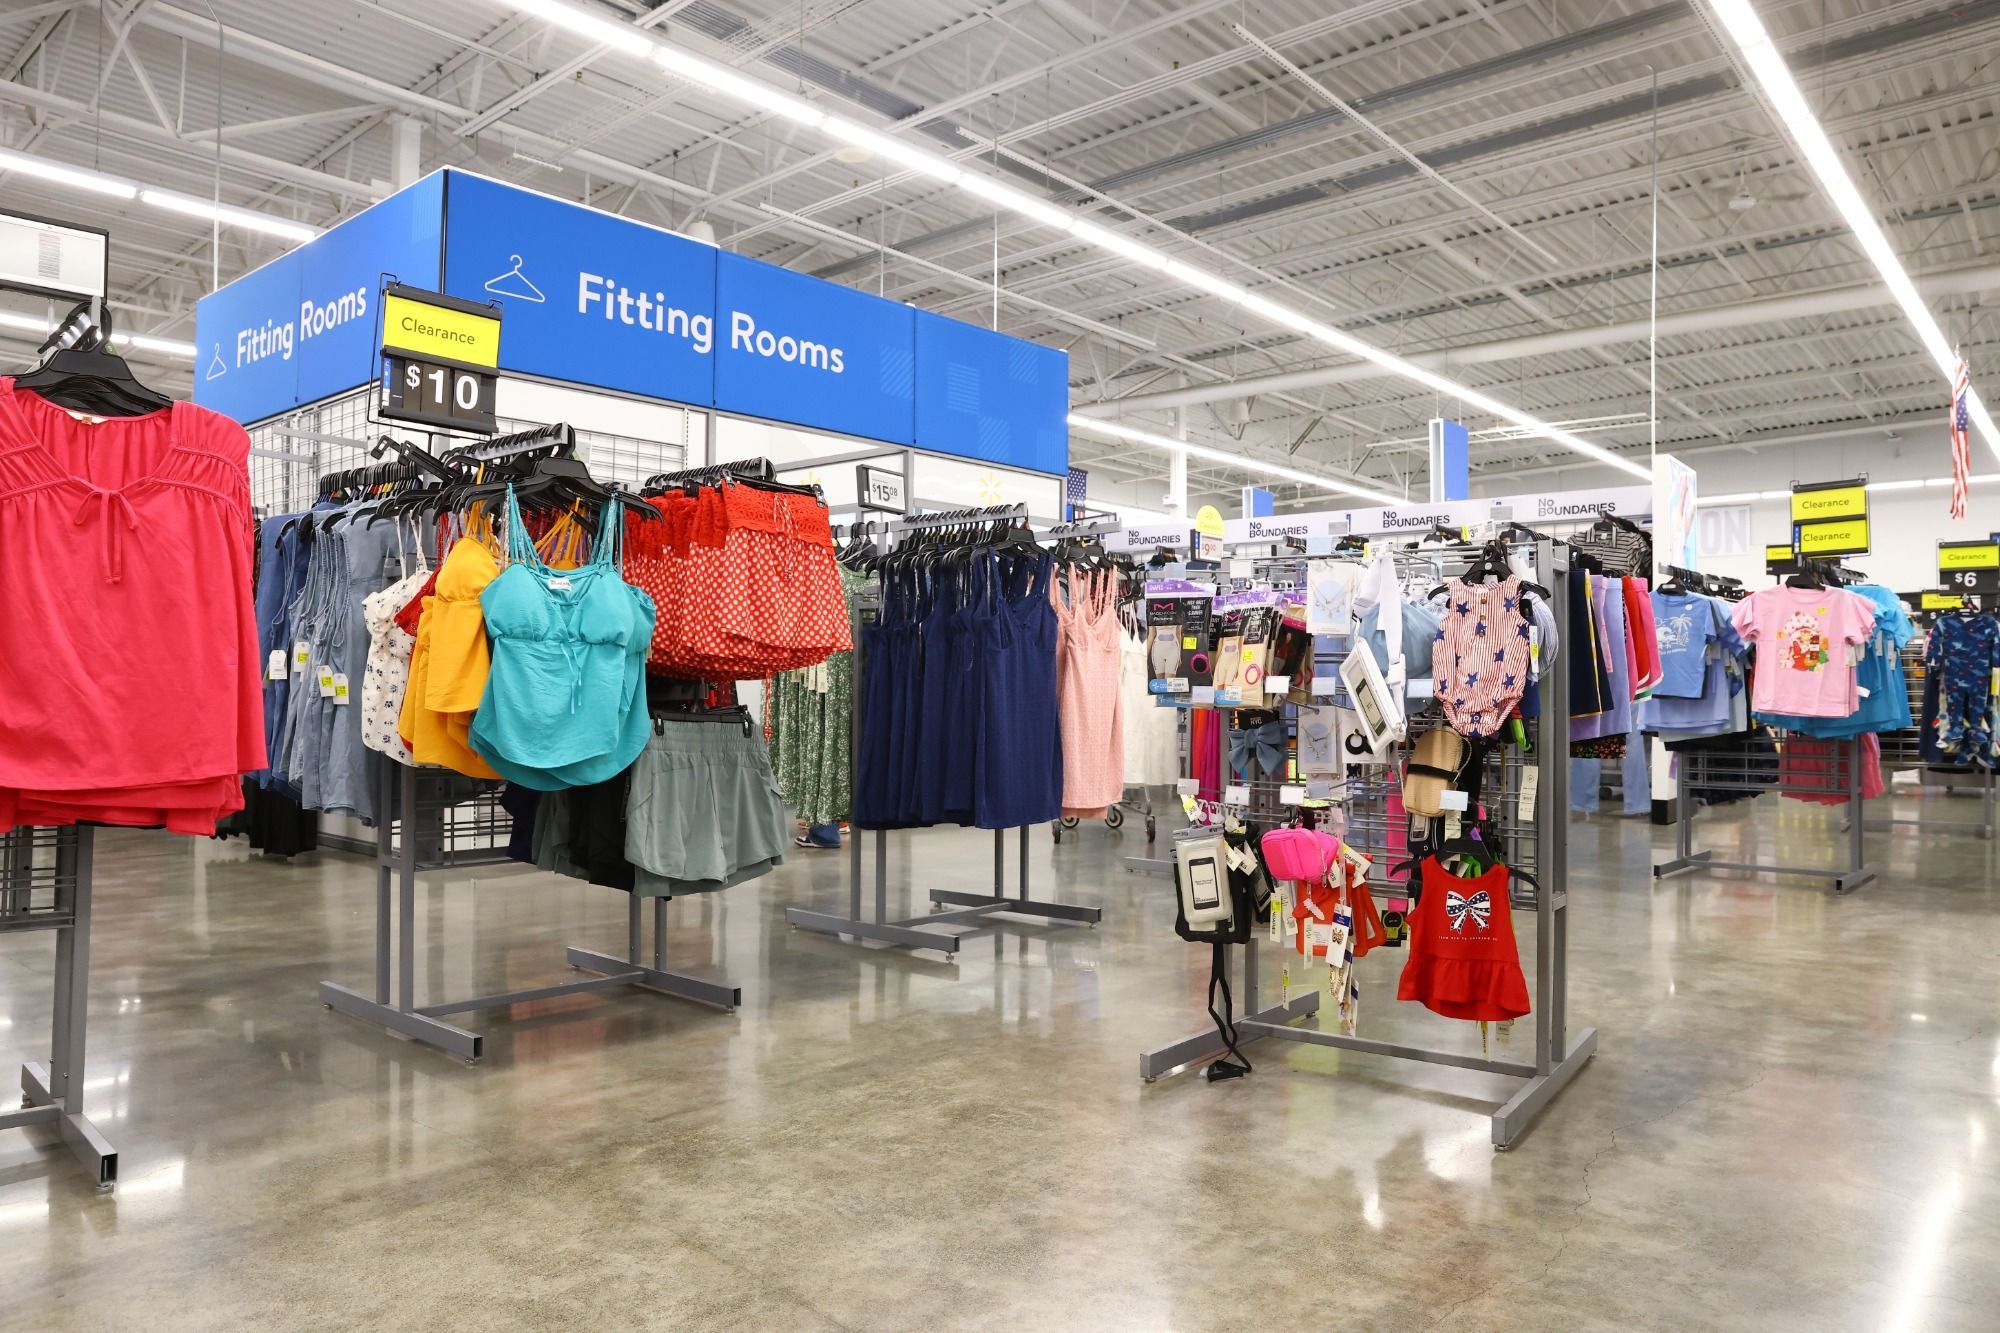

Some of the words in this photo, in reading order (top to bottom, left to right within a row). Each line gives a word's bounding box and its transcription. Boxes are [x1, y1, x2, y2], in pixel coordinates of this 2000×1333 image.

[236, 319, 294, 368] Fitting
[300, 286, 366, 342] Rooms
[401, 316, 475, 345] Clearance
[578, 271, 713, 354] Fitting
[731, 311, 845, 373] Rooms
[406, 363, 479, 410] $10
[1802, 498, 1850, 510] Clearance
[1802, 531, 1851, 543] Clearance
[1947, 553, 1987, 561] Clearance
[1954, 571, 1977, 587] $6
